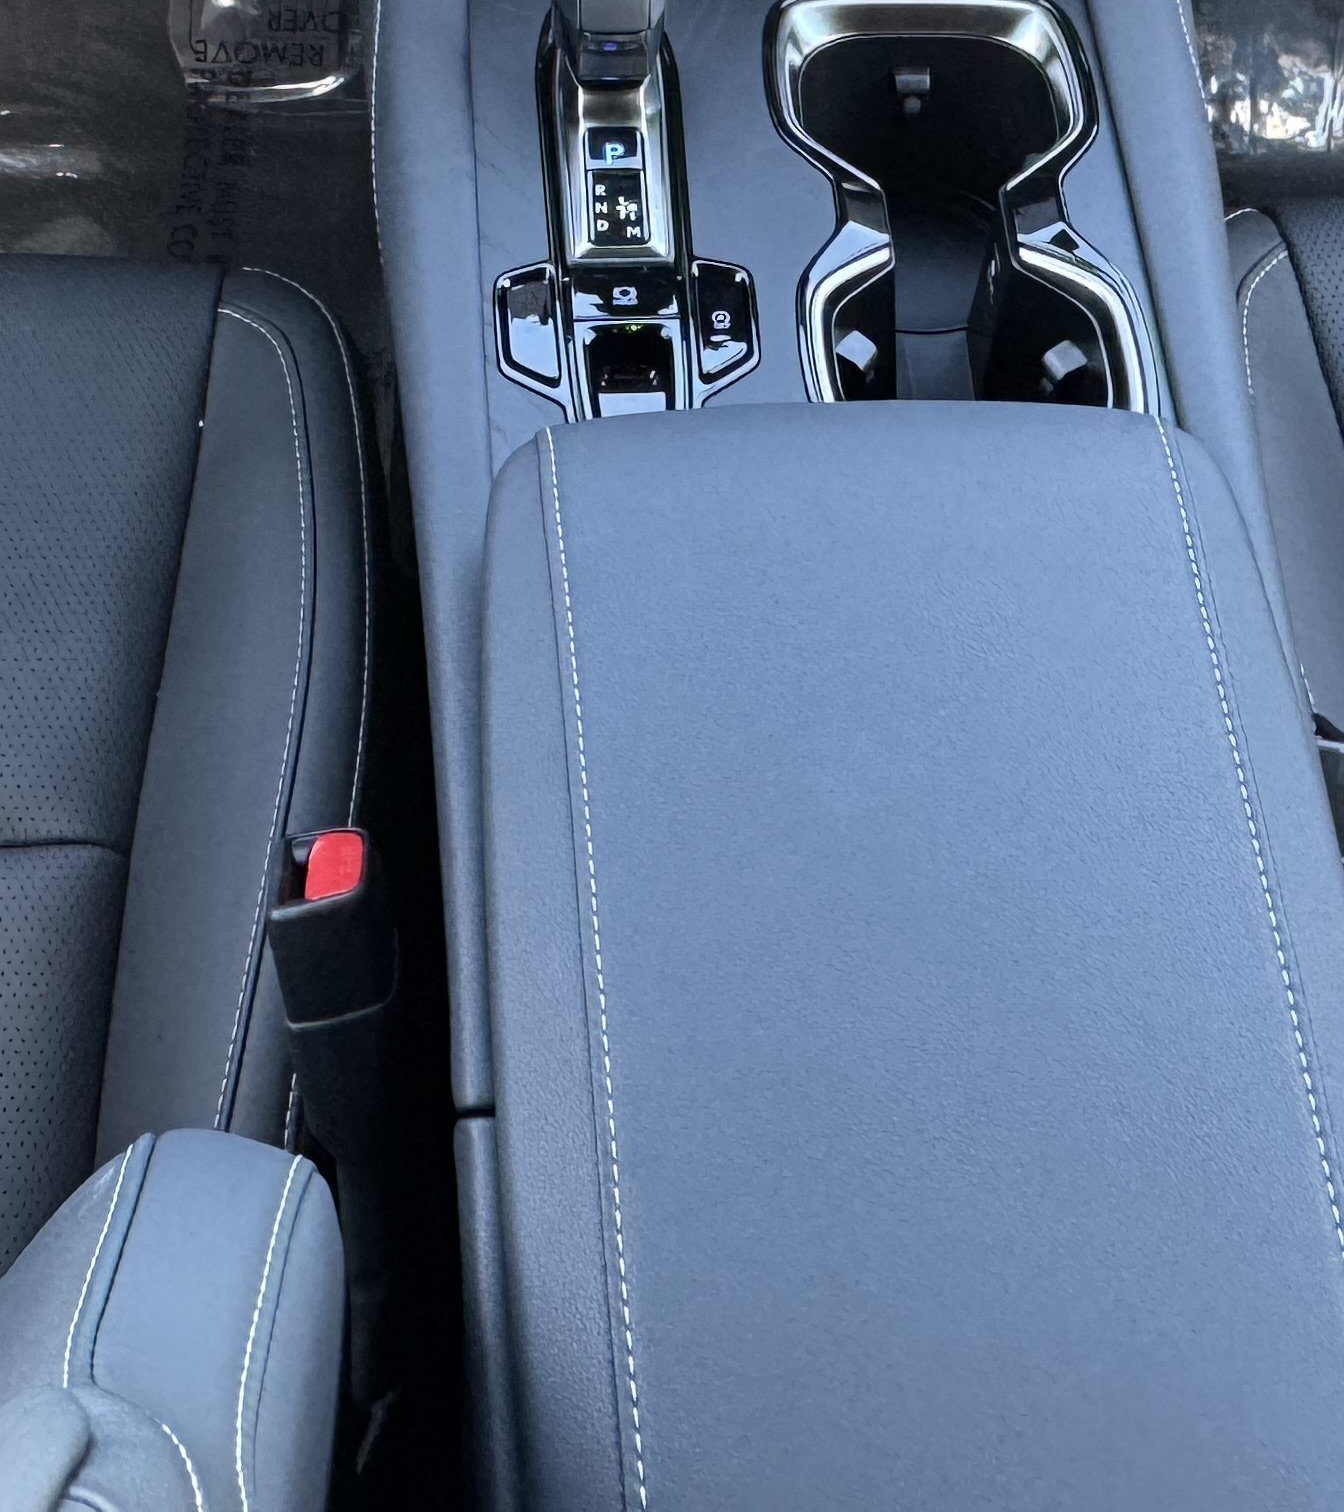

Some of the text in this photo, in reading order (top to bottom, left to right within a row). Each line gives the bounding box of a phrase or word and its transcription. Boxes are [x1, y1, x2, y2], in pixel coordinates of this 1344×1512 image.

[606, 142, 625, 165] P
[594, 184, 607, 196] R
[595, 201, 608, 214] N
[596, 219, 610, 232] D
[626, 226, 642, 238] M
